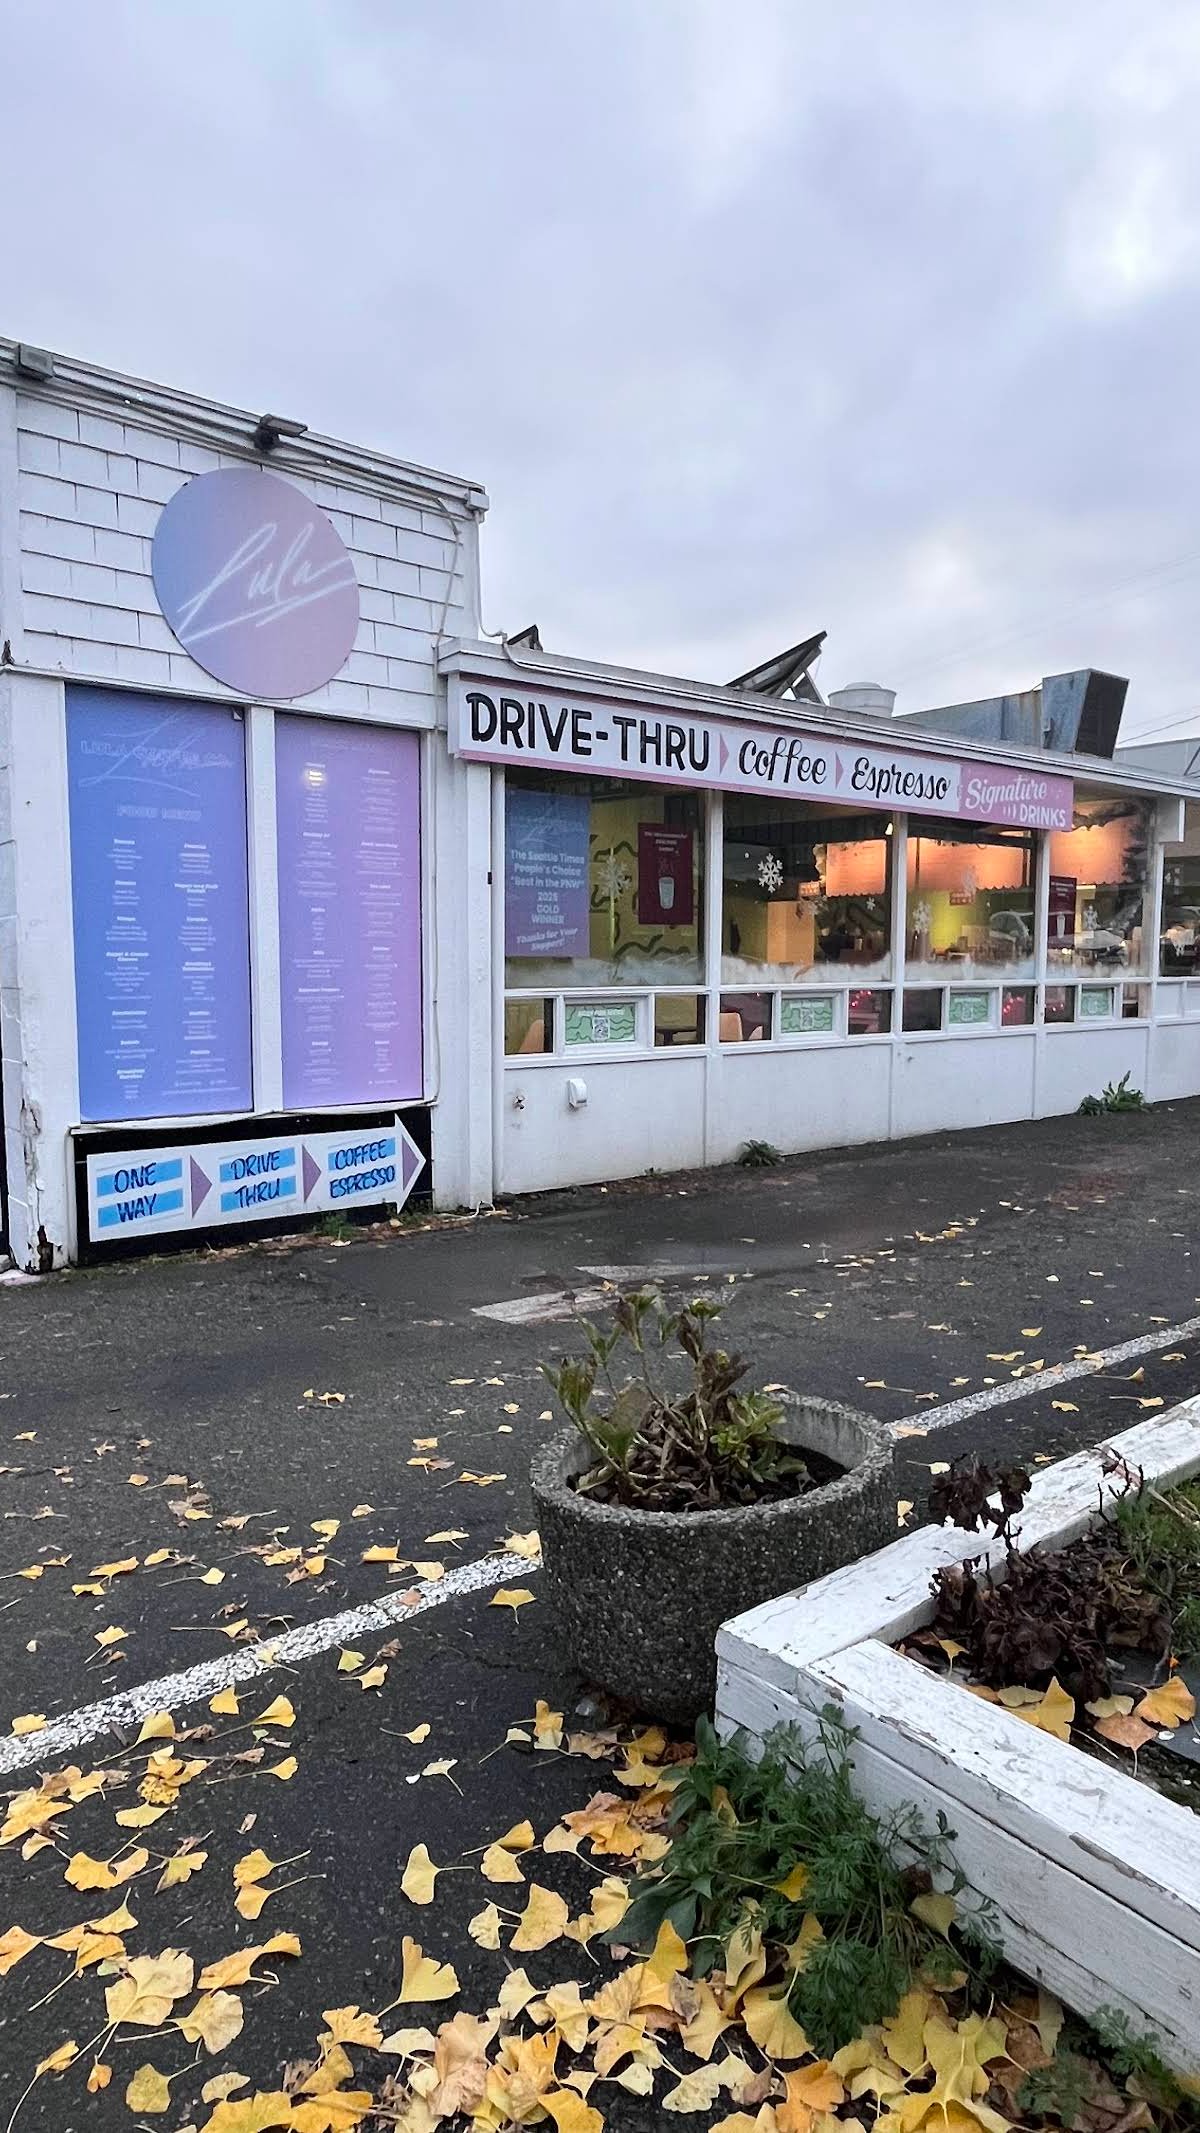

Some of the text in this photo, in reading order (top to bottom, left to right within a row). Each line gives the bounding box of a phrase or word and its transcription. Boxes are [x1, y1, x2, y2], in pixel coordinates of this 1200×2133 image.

[465, 691, 1048, 815] DRIVE-THRU Coffee Espresso Signature
[1019, 804, 1067, 828] DRINKS
[510, 849, 527, 861] The
[560, 853, 585, 865] Times
[513, 862, 582, 877] People's Choice
[545, 878, 560, 889] the
[531, 913, 565, 925] WINNER
[536, 903, 560, 914] GOLD
[230, 1150, 281, 1181] DRIVE
[334, 1138, 388, 1171] COFFEE
[113, 1162, 158, 1194] ONE
[329, 1165, 396, 1200] ESPRESSO
[116, 1193, 158, 1222] WAY
[234, 1178, 282, 1210] THRU
